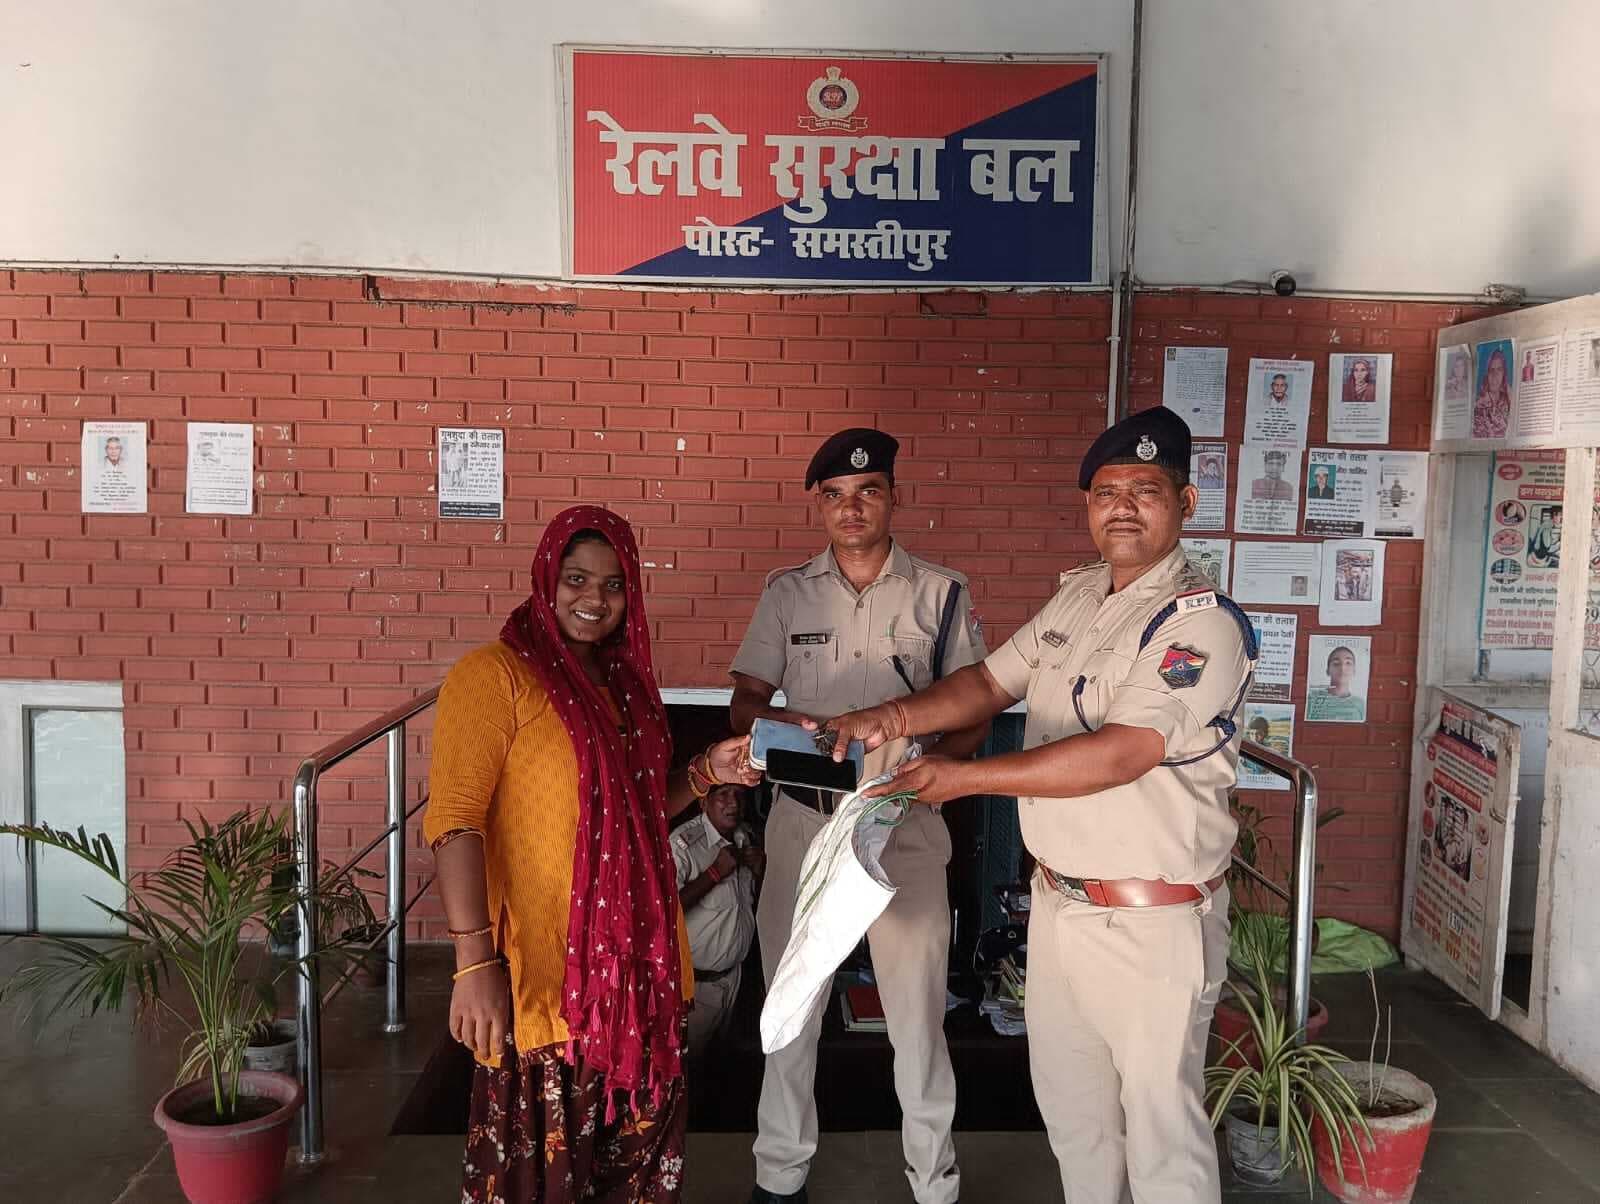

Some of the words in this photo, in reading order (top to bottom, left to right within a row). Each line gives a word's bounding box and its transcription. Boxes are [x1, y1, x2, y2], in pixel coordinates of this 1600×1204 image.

[587, 111, 746, 197] रेलवे
[764, 134, 946, 223] सुरक्षा
[963, 137, 1080, 203] बल
[682, 217, 774, 257] पोस्ट-
[789, 220, 951, 271] समस्तीपुर
[441, 431, 466, 442] गुमशुदा
[468, 430, 478, 440] की
[480, 432, 501, 441] तलाश
